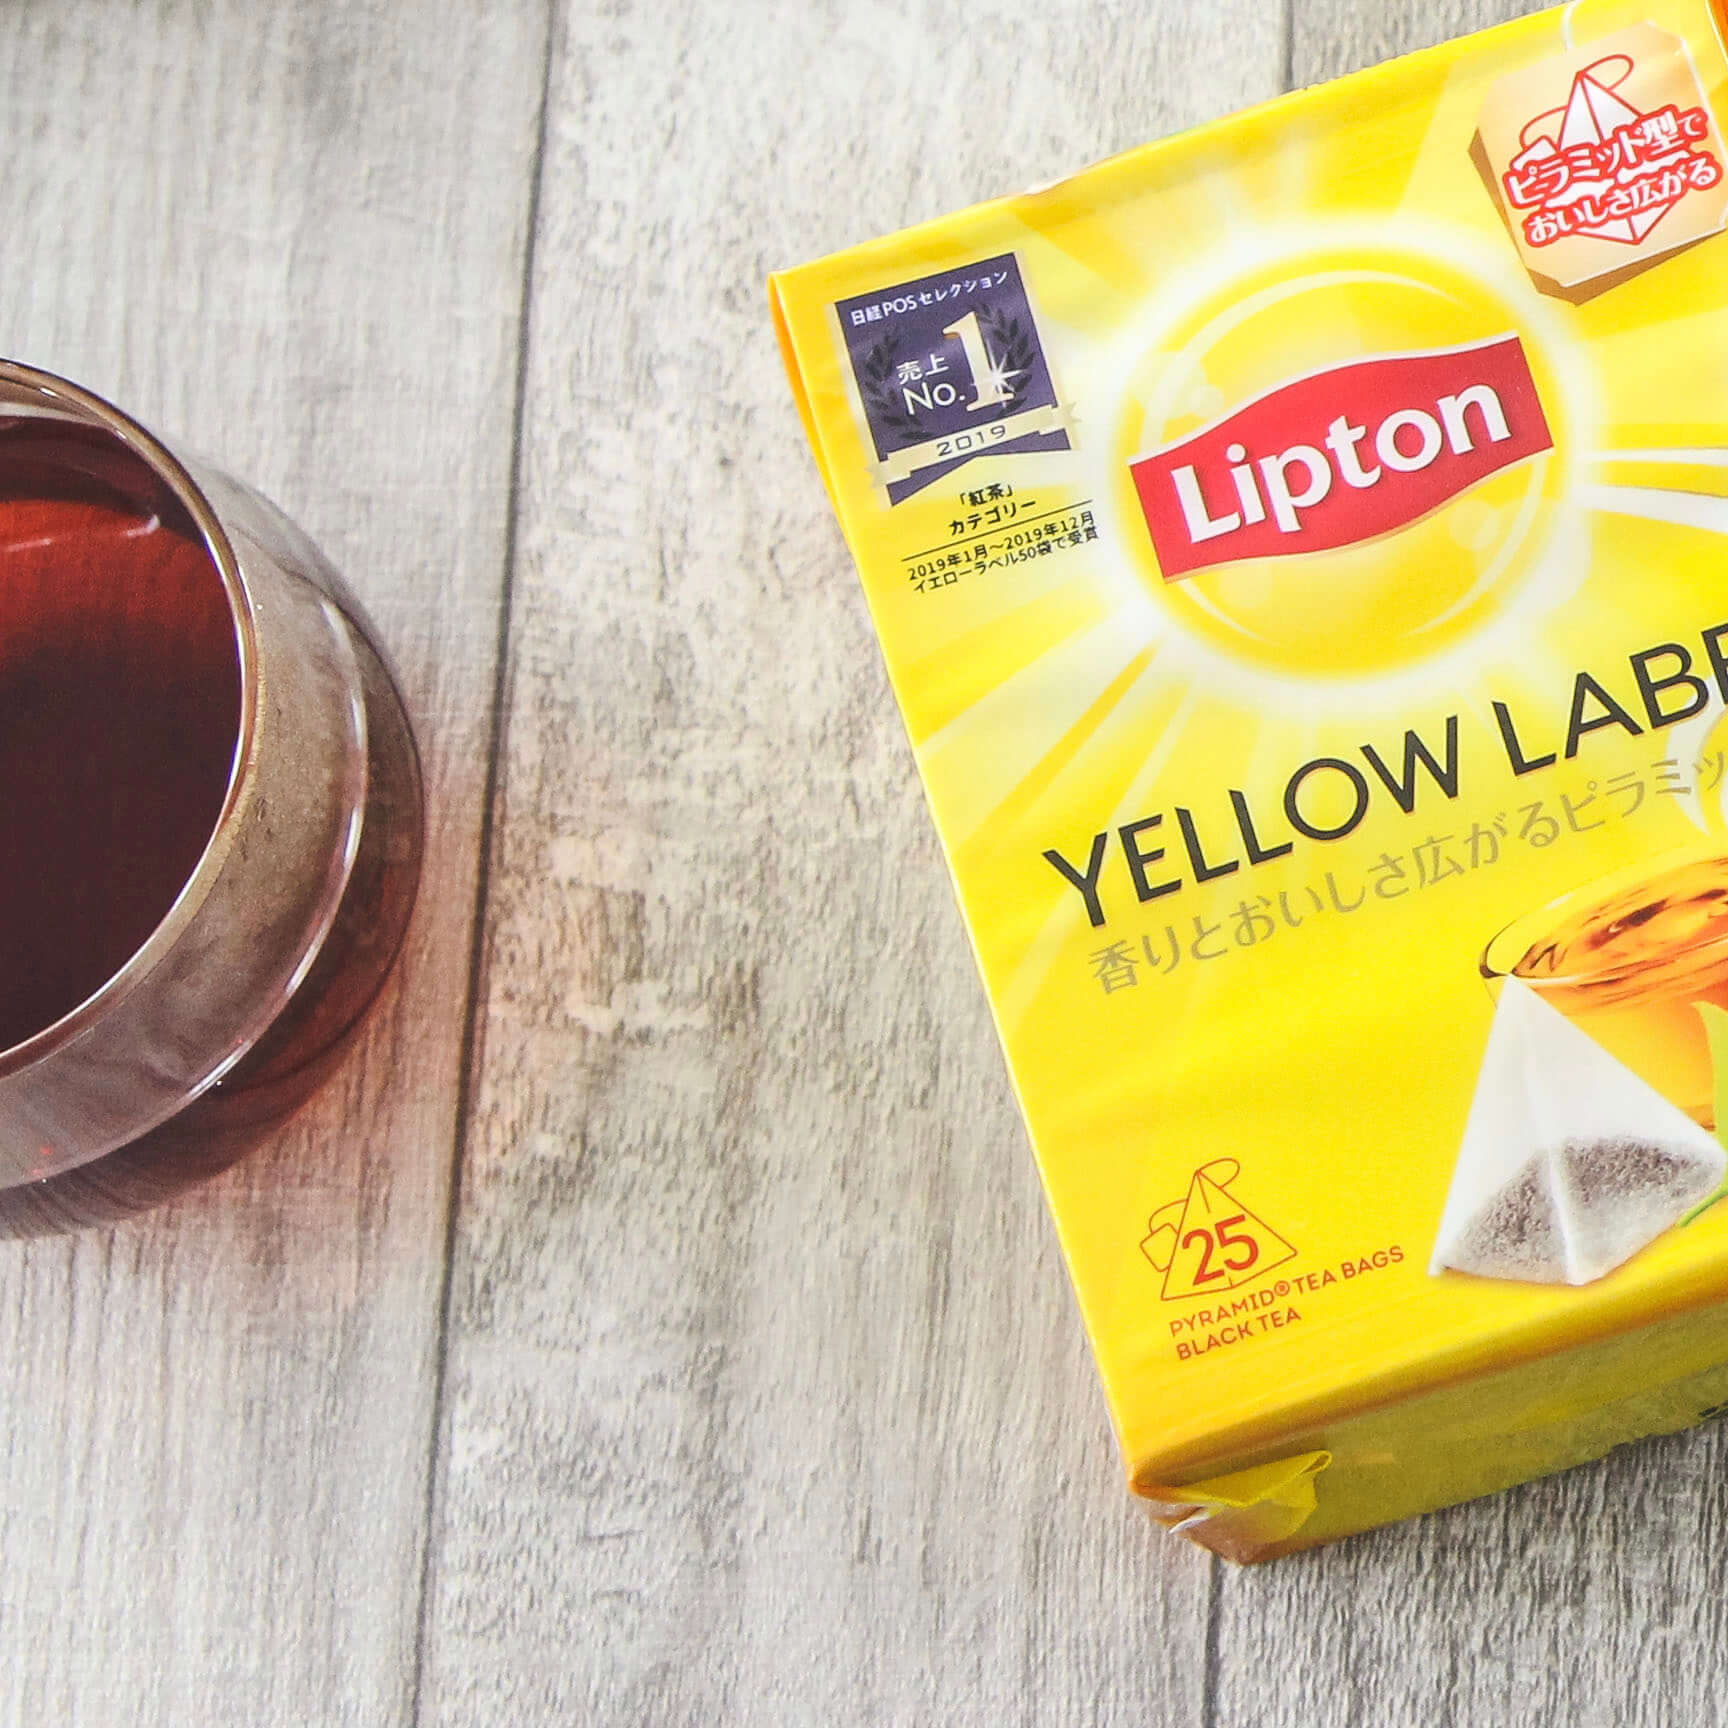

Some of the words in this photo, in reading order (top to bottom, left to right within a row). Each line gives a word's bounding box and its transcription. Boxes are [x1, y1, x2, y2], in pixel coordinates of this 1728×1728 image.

[1508, 112, 1702, 204] ピラミッド型で
[1528, 158, 1718, 242] おいしさ広がる
[850, 271, 1008, 326] 日経POSセレクション
[896, 354, 949, 385] 売上
[937, 425, 1007, 457] 2019
[1171, 379, 1512, 545] Lipton
[948, 499, 1037, 537] カテゴリー
[959, 483, 1014, 507] 「紅茶」
[913, 528, 1099, 595] イエローラベル50袋で受賞
[1044, 716, 1459, 928] YELLOW
[1182, 1214, 1259, 1286] 25
[1293, 1270, 1337, 1295] TEA
[1341, 1246, 1404, 1278] BAGS
[1176, 1321, 1253, 1360] BLACK
[1261, 1307, 1302, 1332] TEA
